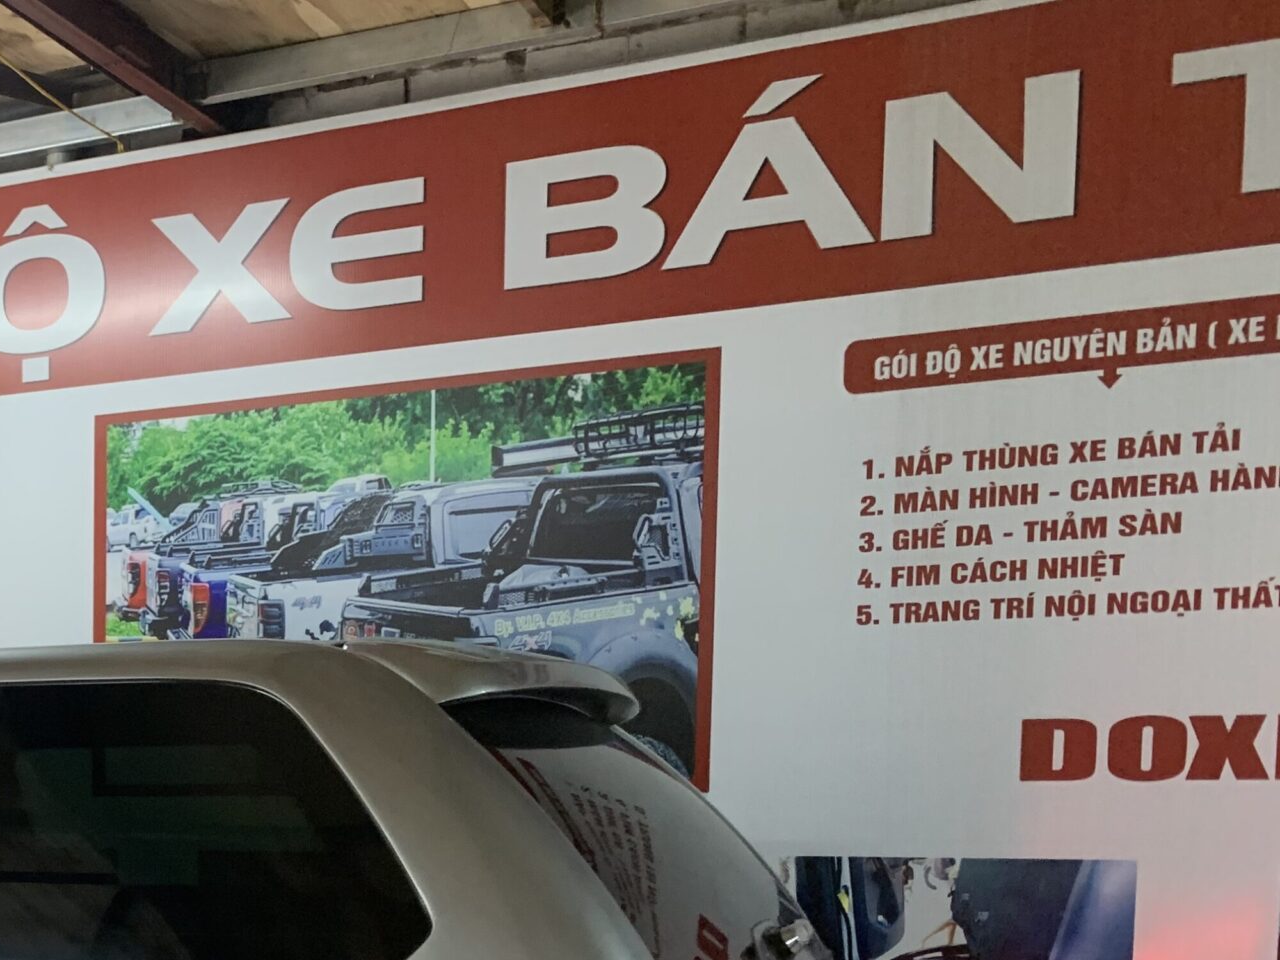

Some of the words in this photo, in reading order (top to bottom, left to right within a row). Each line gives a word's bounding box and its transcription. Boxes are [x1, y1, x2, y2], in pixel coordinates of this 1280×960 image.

[150, 176, 425, 336] XE
[504, 69, 1081, 290] BÁN
[873, 351, 917, 380] GÓI
[925, 343, 962, 378] ĐỘ
[970, 343, 1003, 371] XE
[1013, 327, 1127, 367] NGUYÊN
[1135, 317, 1197, 354] BẢN
[1228, 315, 1266, 345] XE
[862, 458, 885, 481] 1.
[962, 441, 1059, 473] THÙNG
[1069, 439, 1107, 464] XE
[1117, 430, 1182, 460] BÁN
[1192, 422, 1241, 455] TẢI
[859, 494, 884, 517] 2.
[893, 484, 959, 514] MÀN
[968, 480, 1039, 509] HÌNH
[1070, 470, 1198, 501] CAMERA
[1209, 462, 1280, 492] HÀN
[858, 531, 883, 553] 3.
[892, 519, 949, 551] GHẾ
[955, 523, 993, 547] DA
[1023, 511, 1108, 543] THẢM
[1118, 508, 1183, 538] SÀN
[857, 568, 882, 589] 4.
[890, 564, 941, 588] FIM
[950, 555, 1028, 585] CÁCH
[1037, 550, 1125, 583] NHIỆT
[855, 603, 880, 626] 5.
[889, 598, 981, 624] TRANG
[990, 591, 1035, 620] TRÍ
[1045, 589, 1096, 621] NỘI
[1106, 588, 1203, 618] NGOẠI
[1019, 714, 1280, 782] DOX
